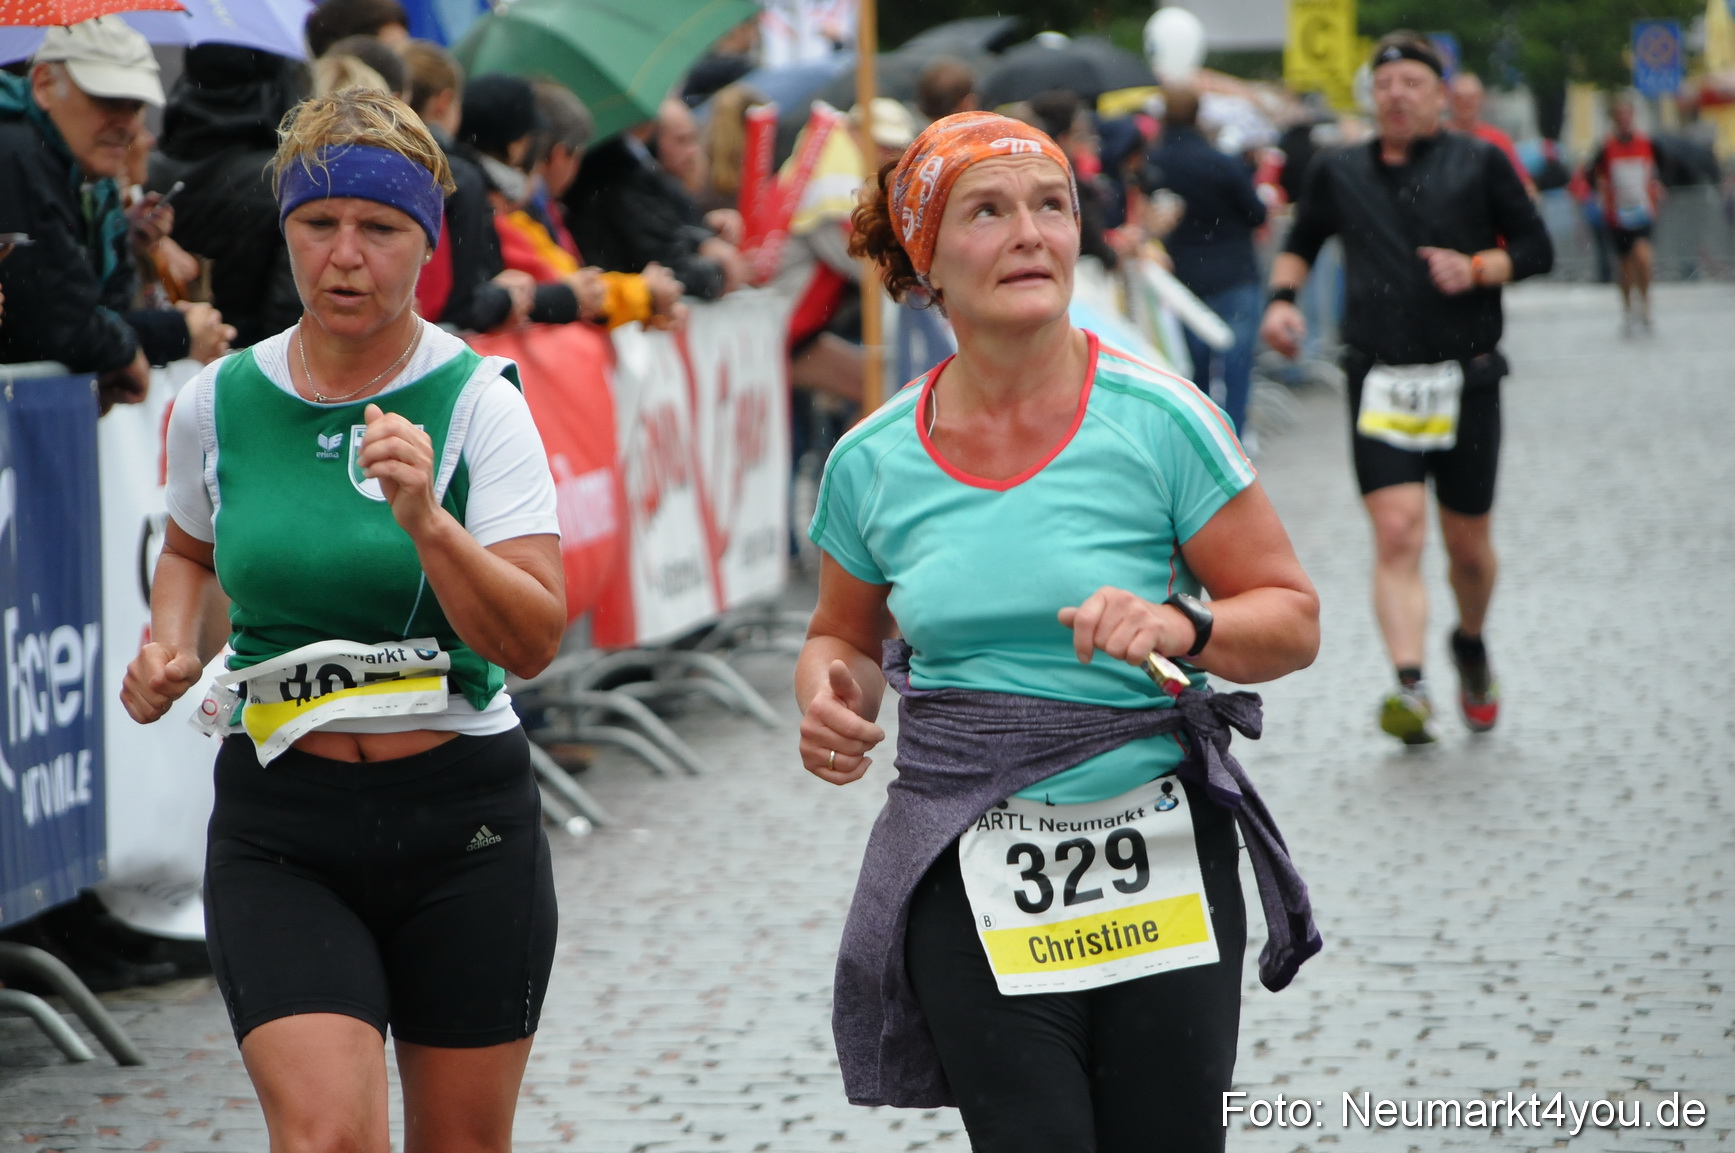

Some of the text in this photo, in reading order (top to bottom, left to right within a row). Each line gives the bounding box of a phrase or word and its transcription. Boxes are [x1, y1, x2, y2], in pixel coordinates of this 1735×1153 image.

[964, 807, 1145, 833] ARTL Neumarkt
[466, 834, 502, 852] adidas
[1006, 827, 1150, 915] 329
[983, 915, 992, 928] B
[1028, 918, 1160, 965] Christine
